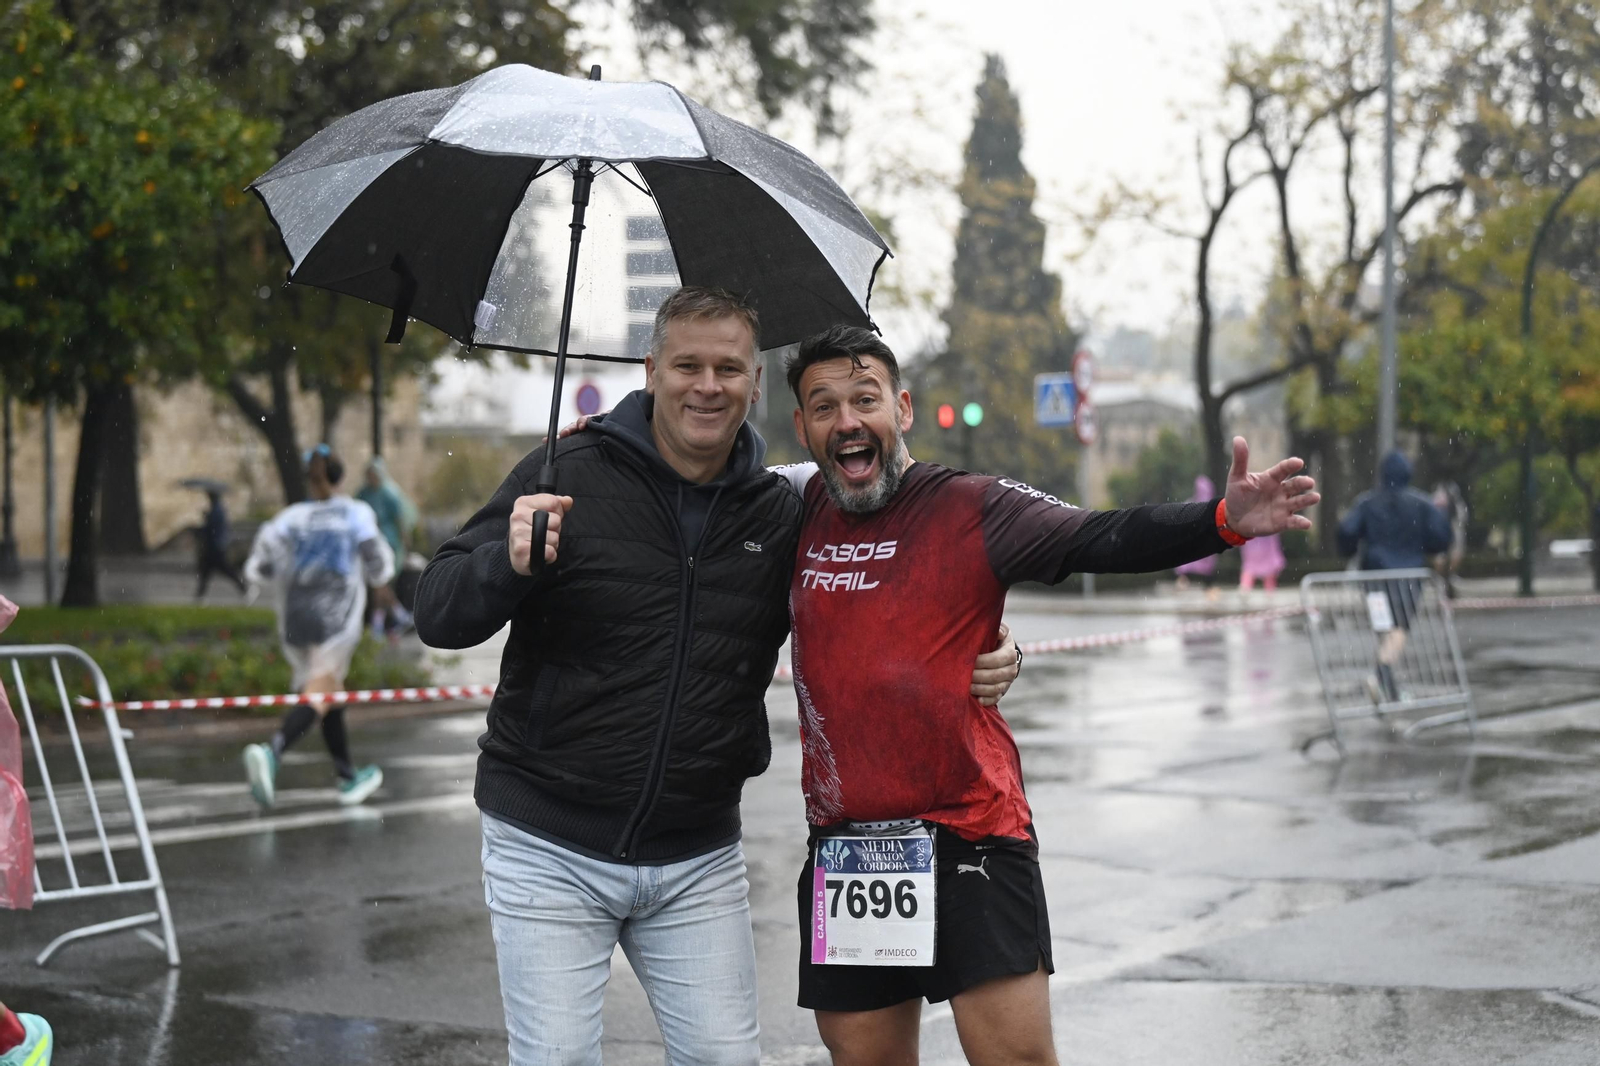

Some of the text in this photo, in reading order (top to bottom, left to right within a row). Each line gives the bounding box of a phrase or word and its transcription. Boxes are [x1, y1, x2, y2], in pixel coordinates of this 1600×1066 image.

[806, 540, 897, 563] LOBOS
[801, 569, 880, 592] TRAIL
[861, 840, 904, 852] MEDIA
[916, 840, 925, 868] 2025
[825, 879, 918, 919] 7696
[816, 890, 824, 939] CAJÓN 5
[884, 948, 917, 957] IMDECO
